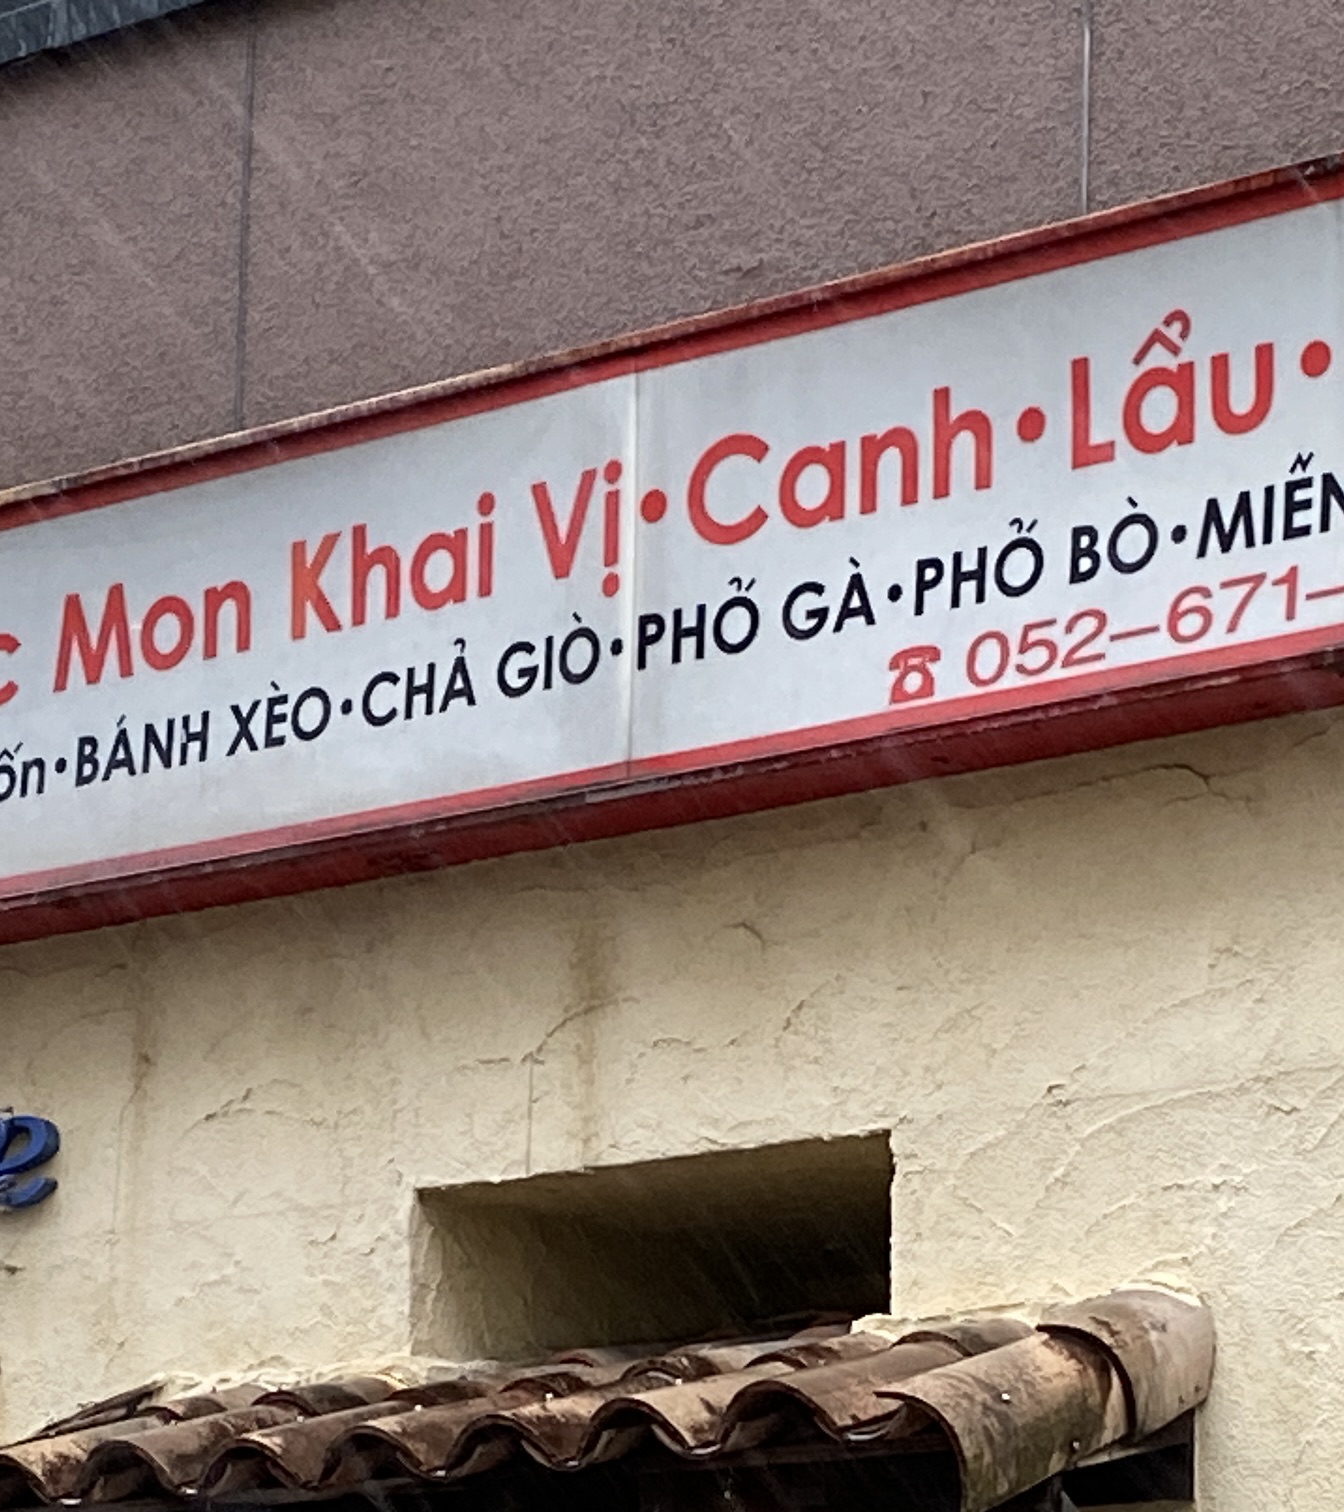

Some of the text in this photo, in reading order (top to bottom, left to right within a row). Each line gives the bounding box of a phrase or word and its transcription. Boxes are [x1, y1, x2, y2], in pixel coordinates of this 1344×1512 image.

[54, 580, 252, 692] Mon
[290, 491, 494, 640] Khai
[686, 385, 994, 547] Canh
[74, 712, 211, 789] BÁNH
[227, 680, 333, 757] XÈO
[361, 636, 477, 728] CHẢ
[496, 611, 602, 700] GIÒ
[781, 555, 877, 642] GÀ
[1068, 495, 1160, 586] BÒ
